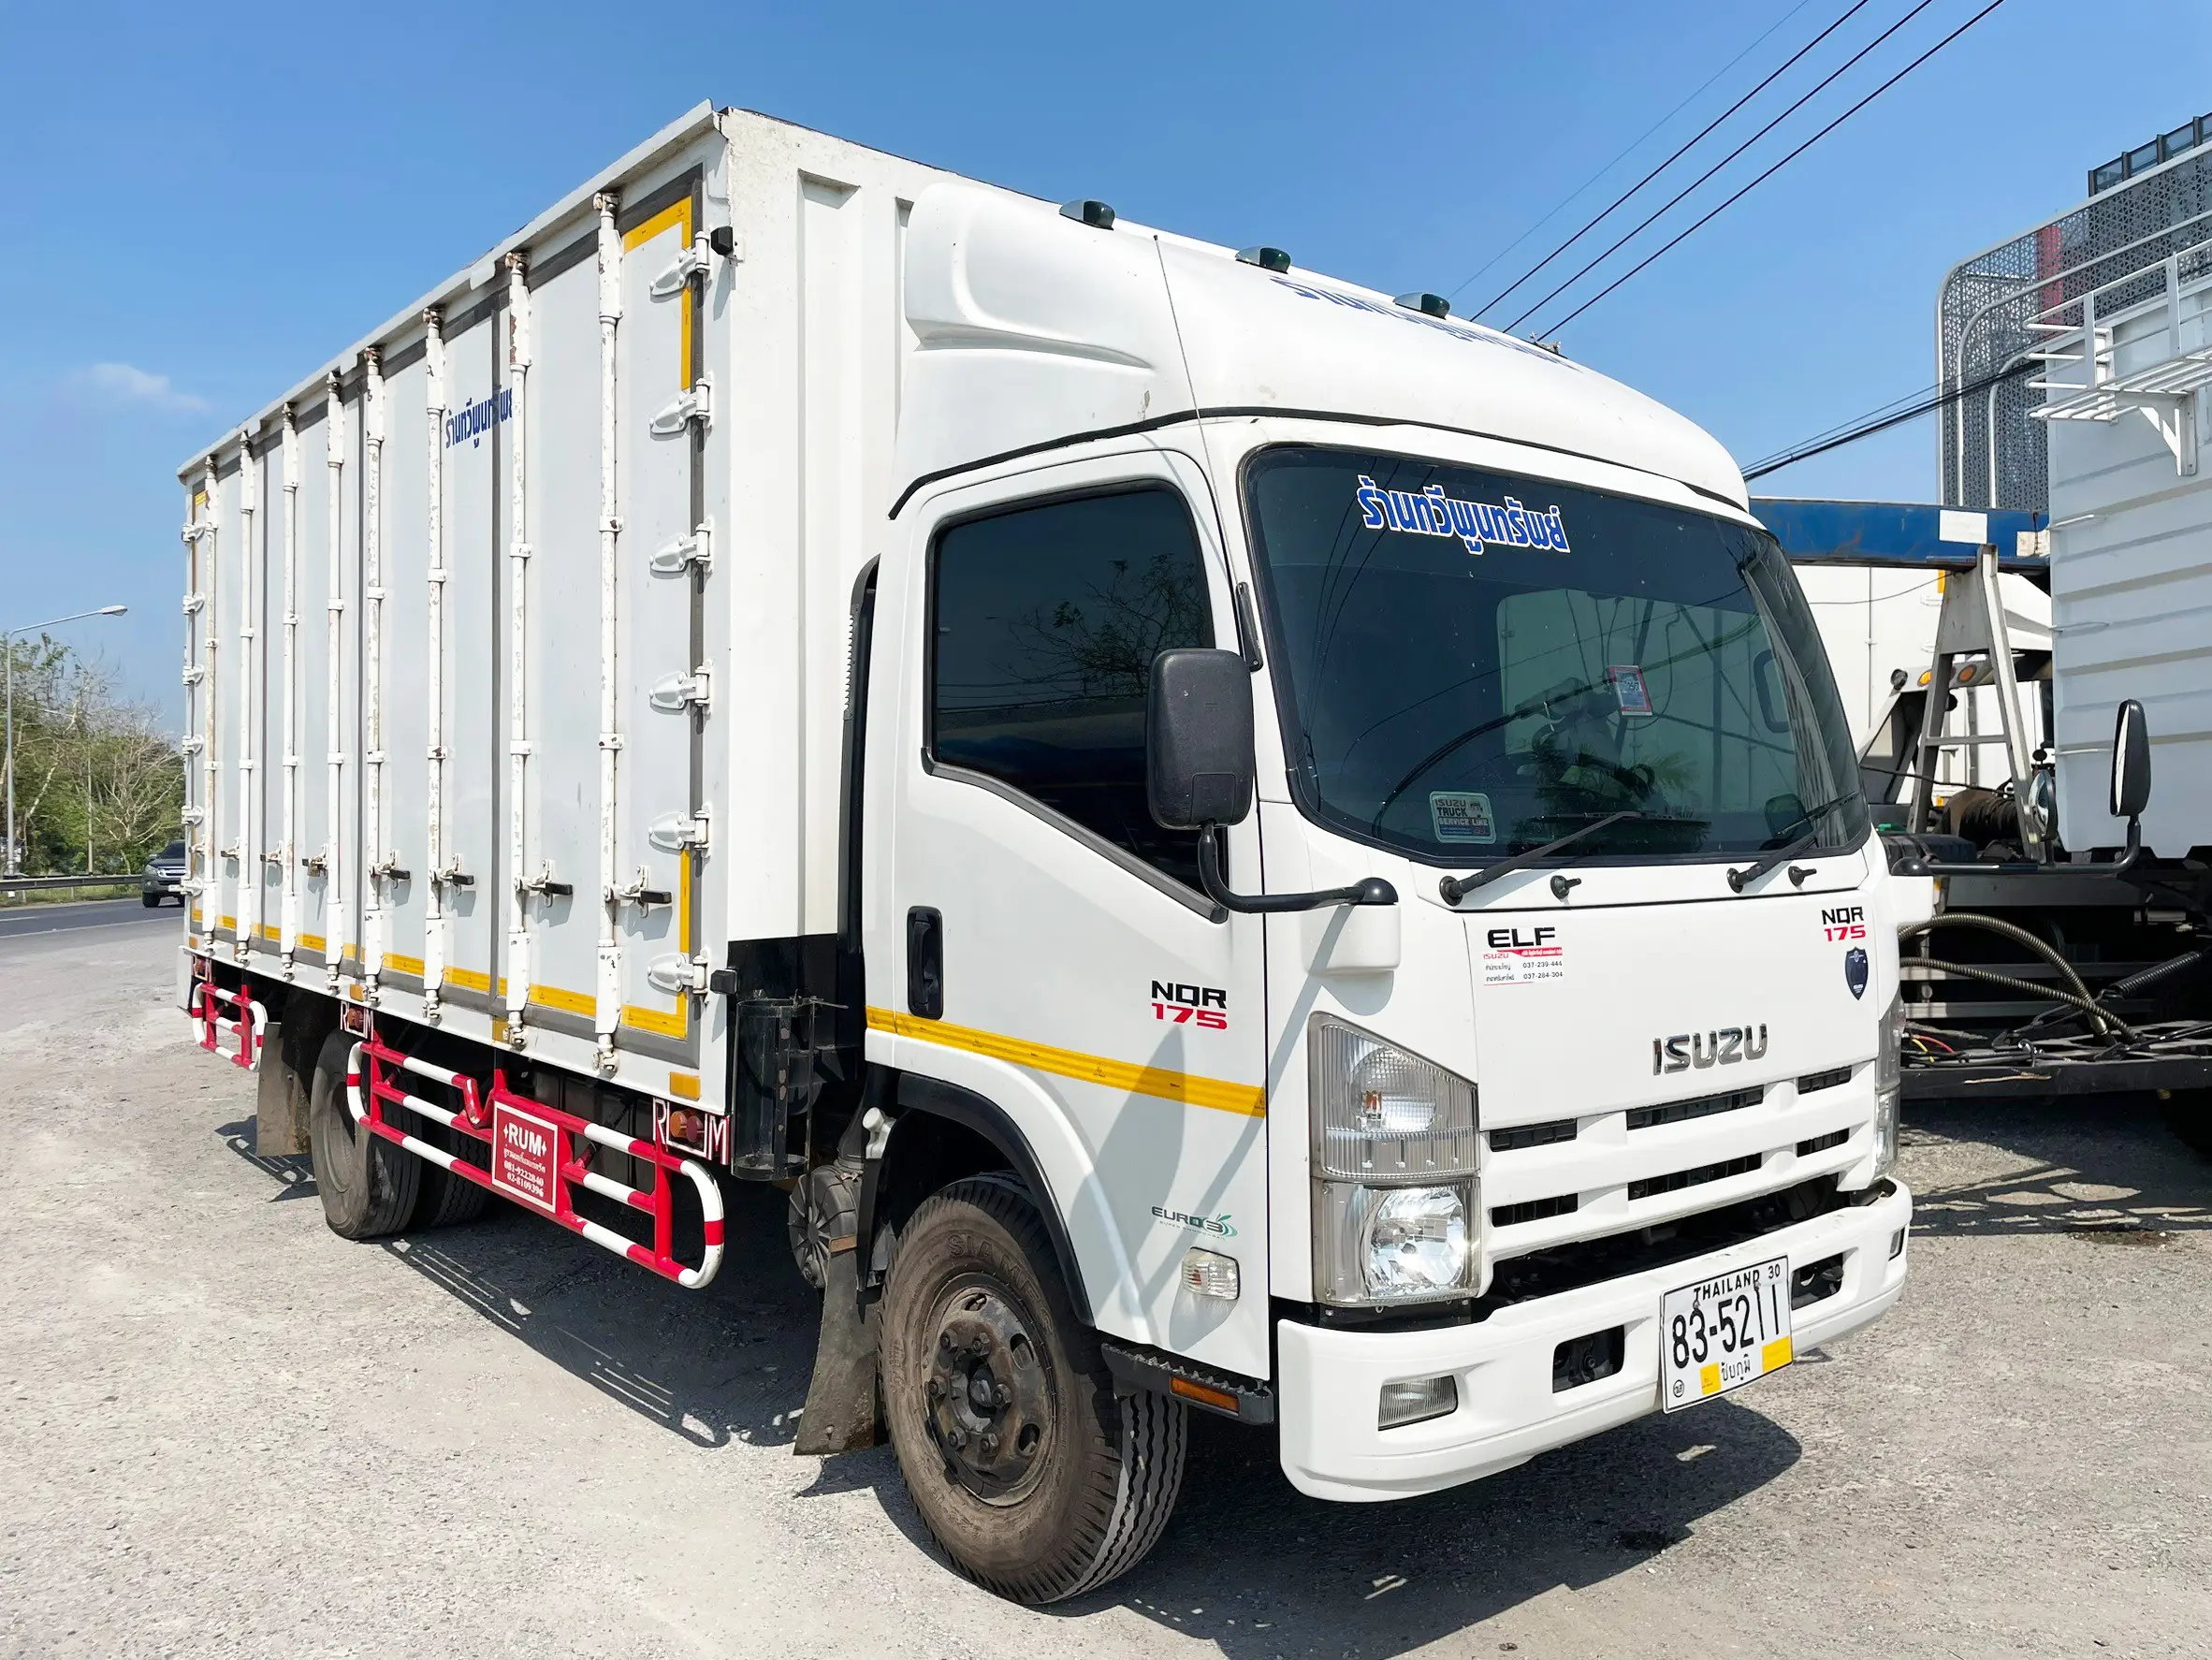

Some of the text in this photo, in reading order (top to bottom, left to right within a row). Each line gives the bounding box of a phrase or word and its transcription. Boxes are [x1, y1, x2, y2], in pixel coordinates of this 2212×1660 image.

[1358, 474, 1571, 555] ร้านทวีพูนทรัพย์
[1434, 798, 1466, 808] ISUZU
[1436, 807, 1468, 817] TRUCK
[1821, 906, 1865, 925] NQR
[1487, 926, 1556, 949] ELF
[1824, 925, 1867, 942] 175
[1522, 960, 1563, 968] 037-239-444
[1522, 971, 1564, 980] 037-284-304
[1151, 979, 1228, 1010] NQR
[1151, 1002, 1228, 1030] 175
[1652, 1023, 1768, 1076] ISUZU
[508, 1122, 543, 1158] RUM
[652, 1096, 730, 1166] RUM
[1694, 1263, 1781, 1302] THAILAND 30
[1672, 1283, 1780, 1369] 83-5211
[1721, 1353, 1752, 1382] ชัยภูมิ
